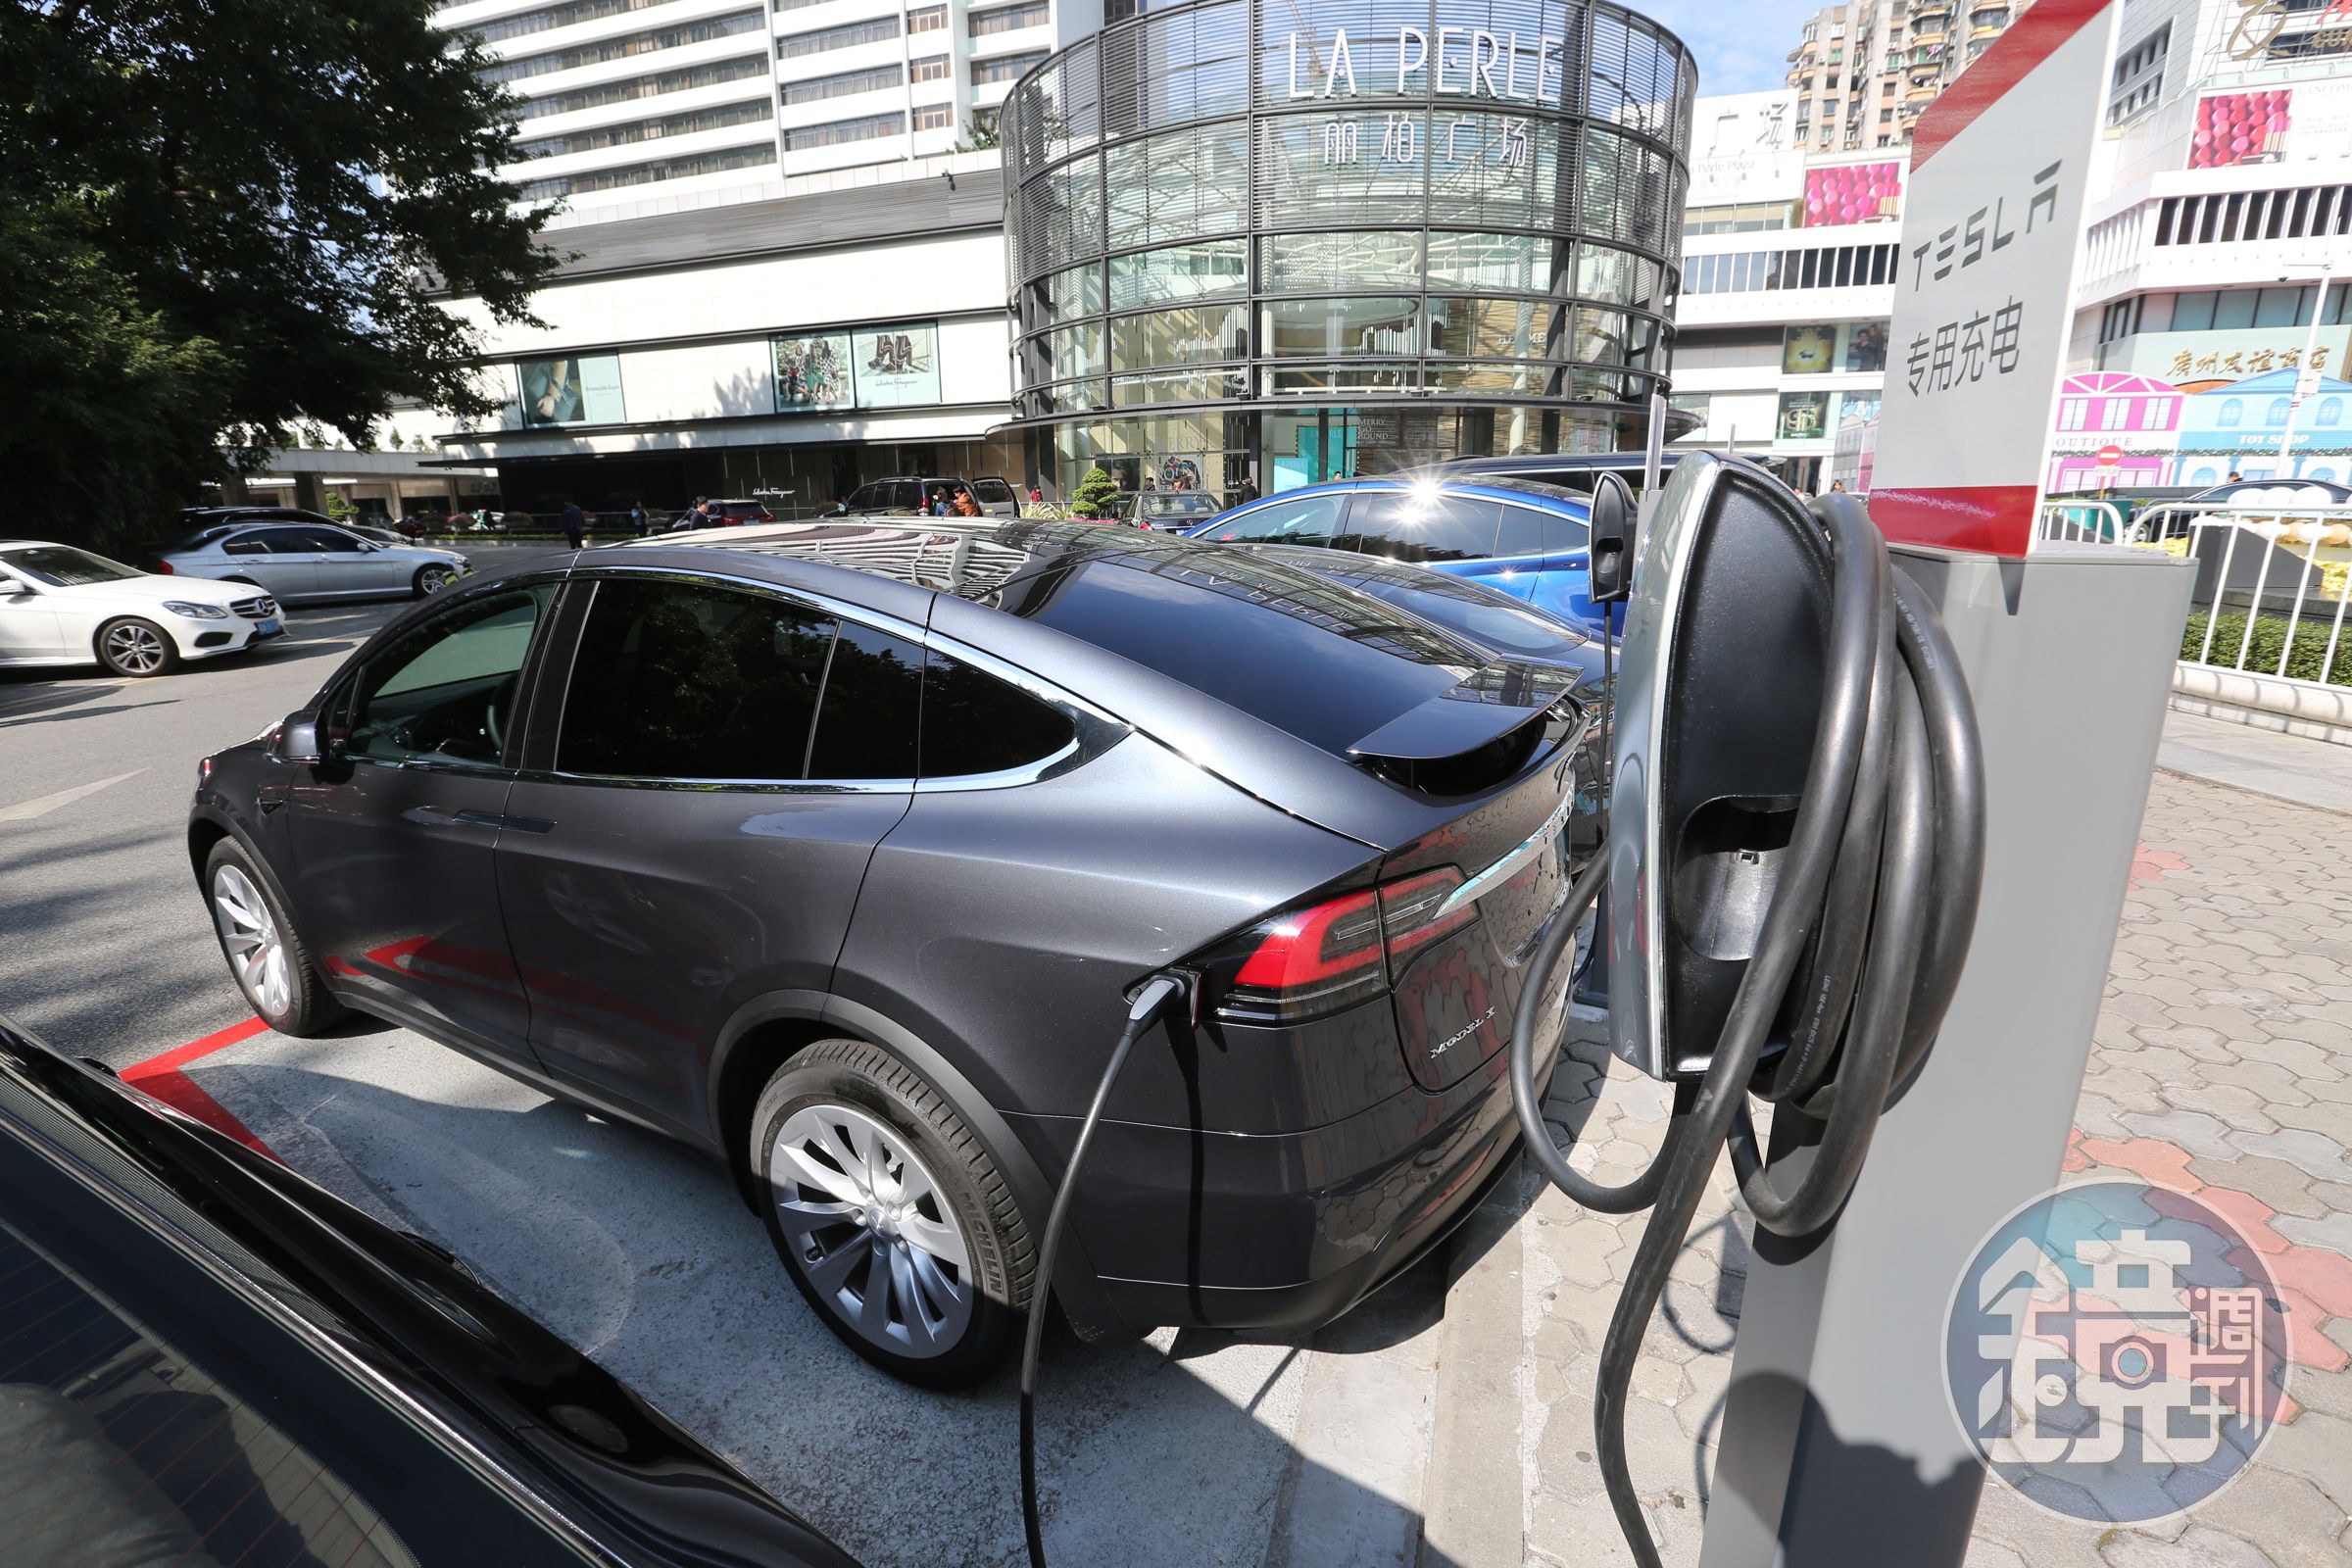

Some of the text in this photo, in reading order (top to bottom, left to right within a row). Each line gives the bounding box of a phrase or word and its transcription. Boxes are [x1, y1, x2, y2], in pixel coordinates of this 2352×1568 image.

[1289, 26, 1565, 103] LA PERLE
[2298, 82, 2352, 95] LANCOM
[1324, 112, 1529, 167] 丽柏广场
[1913, 159, 2063, 292] TESLA
[1907, 295, 2024, 397] 专用充电
[2053, 436, 2133, 448] OUTIQUE
[2238, 434, 2266, 445] TOY
[1430, 1005, 1495, 1059] MODEL X
[959, 1192, 1004, 1295] MICHELIN
